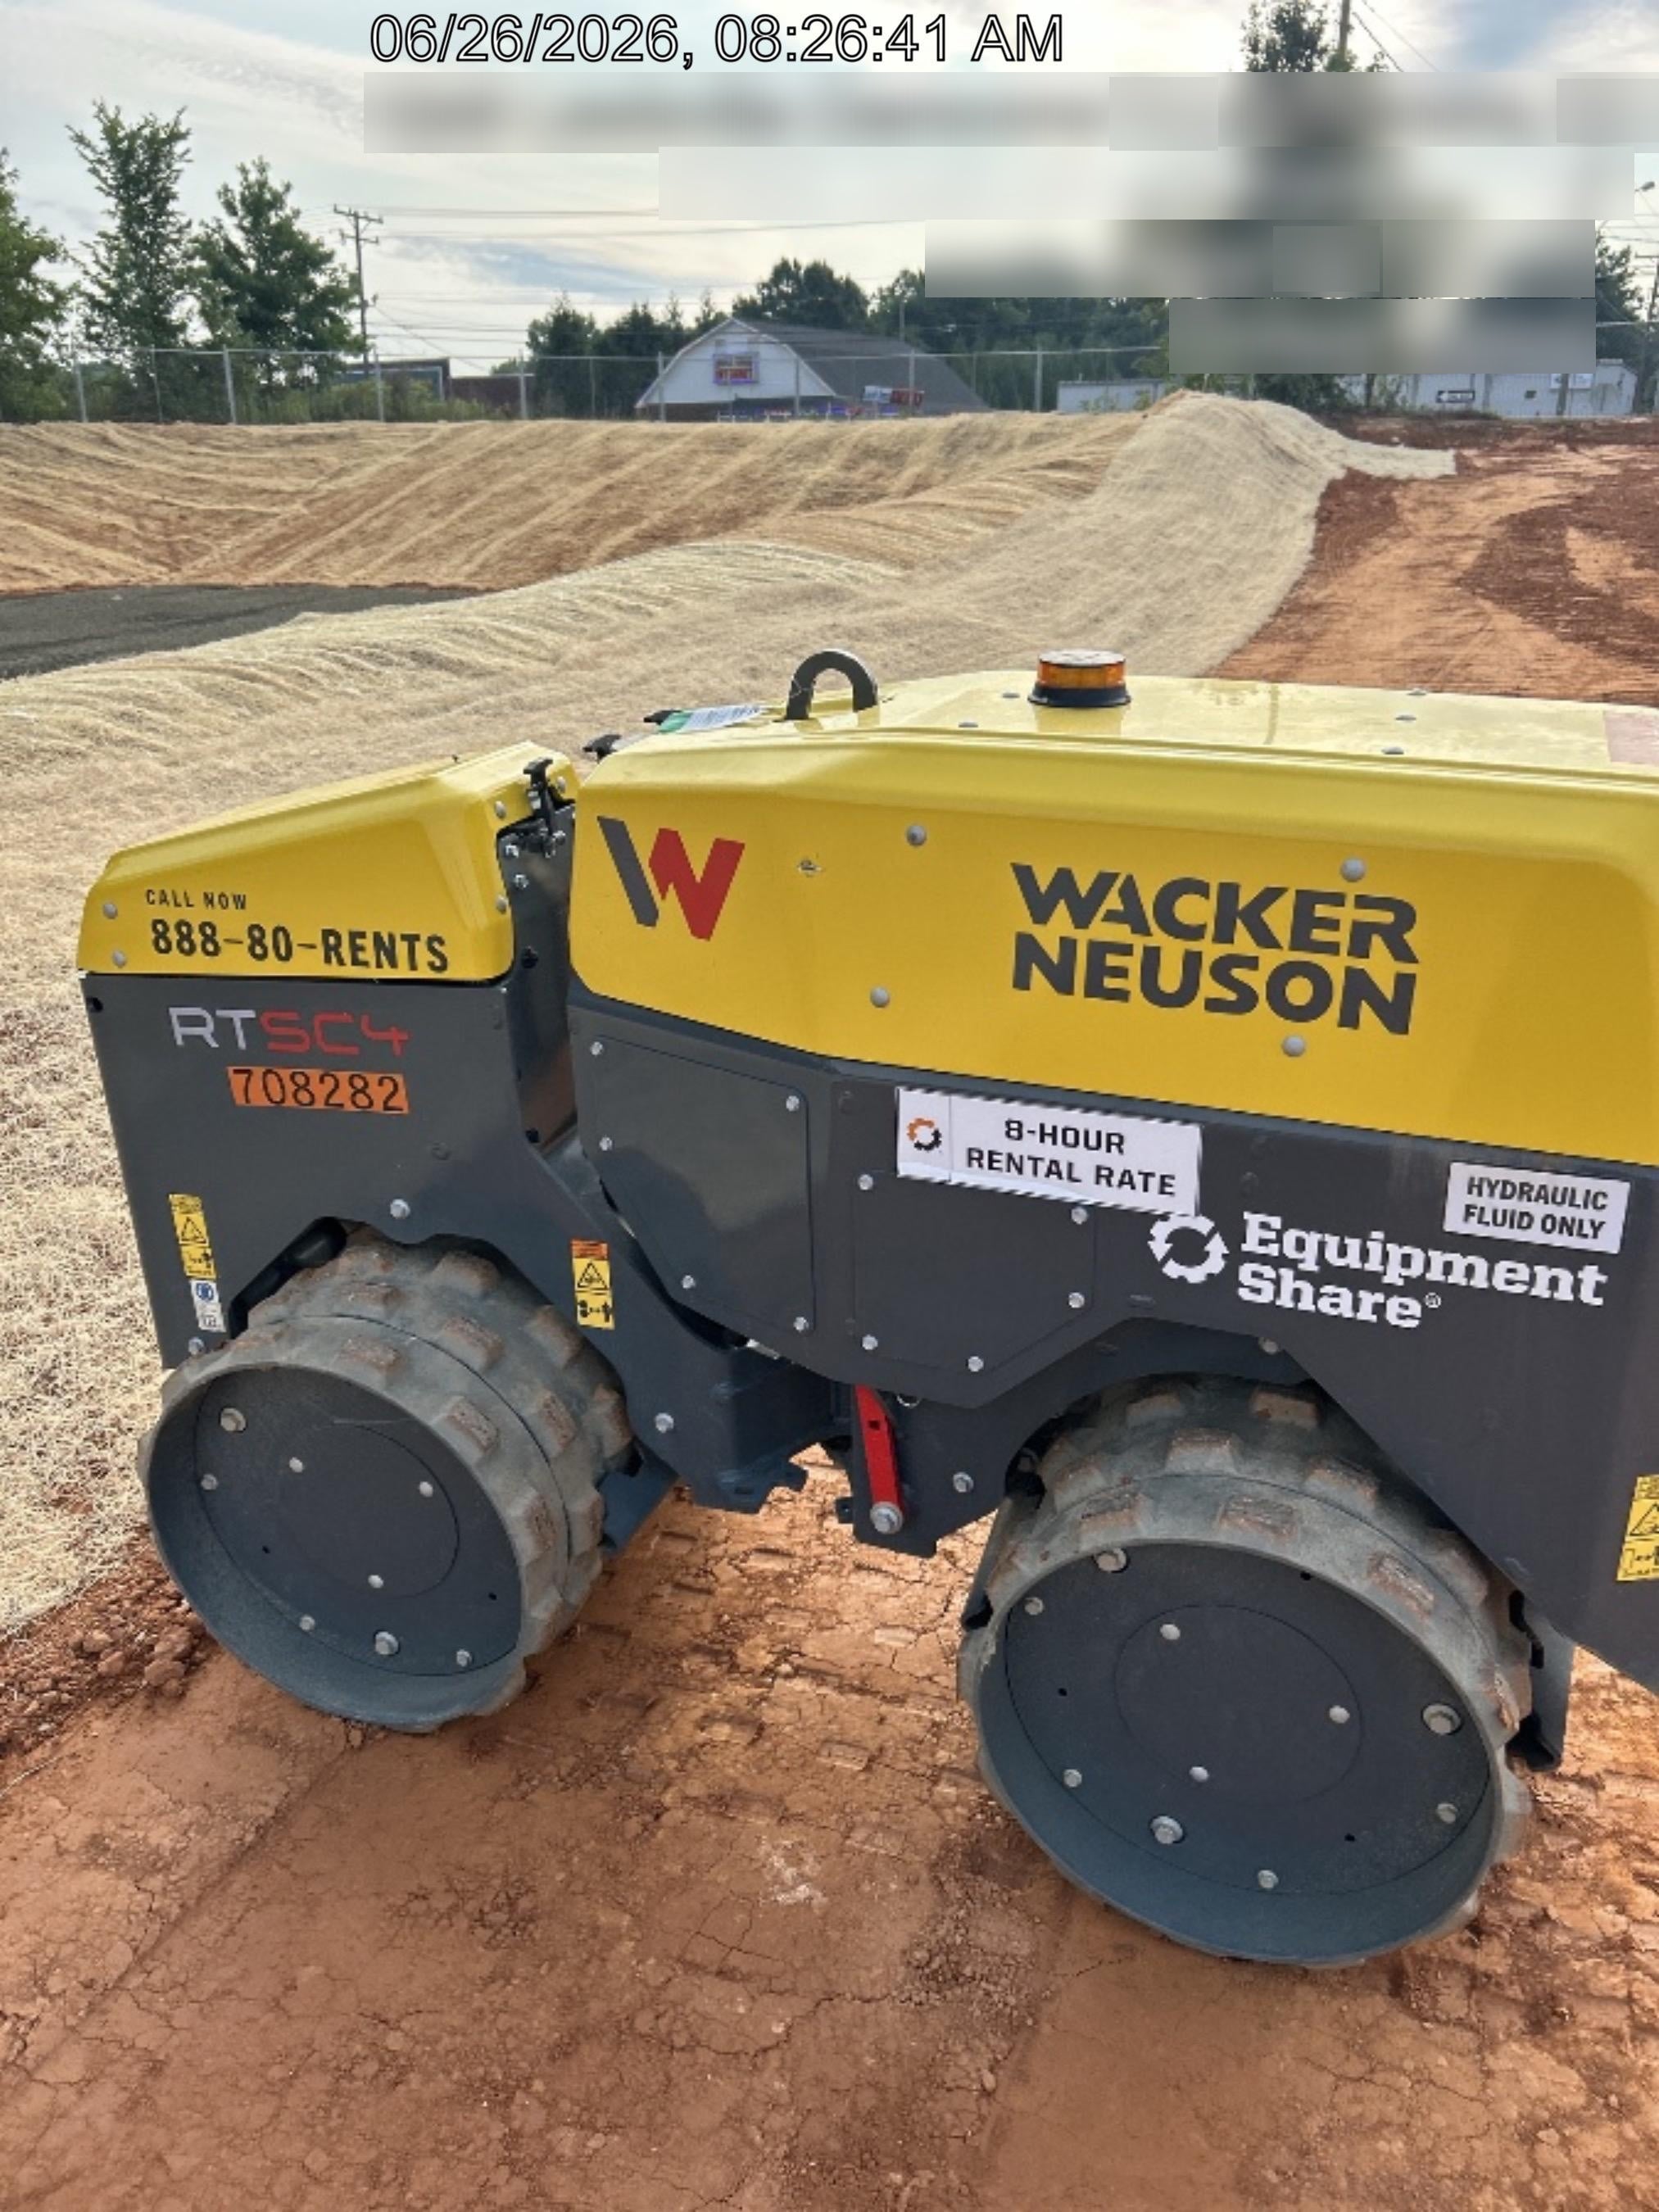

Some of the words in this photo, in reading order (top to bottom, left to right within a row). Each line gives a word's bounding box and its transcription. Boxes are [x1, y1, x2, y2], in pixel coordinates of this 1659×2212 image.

[145, 888, 195, 909] CALL
[202, 891, 247, 911] NOW
[1010, 862, 1420, 963] WACKER
[151, 918, 450, 974] 888-80-RENTS
[1013, 931, 1418, 1036] NEUSON
[168, 1005, 410, 1056] RTSC4
[231, 1067, 405, 1113] 708282
[1004, 1118, 1125, 1155] 8-HOUR
[966, 1147, 1082, 1184] RENTAL
[1094, 1163, 1176, 1197] RATE
[1466, 1176, 1609, 1212] HYDRAULIC
[1462, 1203, 1534, 1231] FLUID
[1540, 1213, 1607, 1240] ONLY
[1240, 1211, 1608, 1307] Equipment
